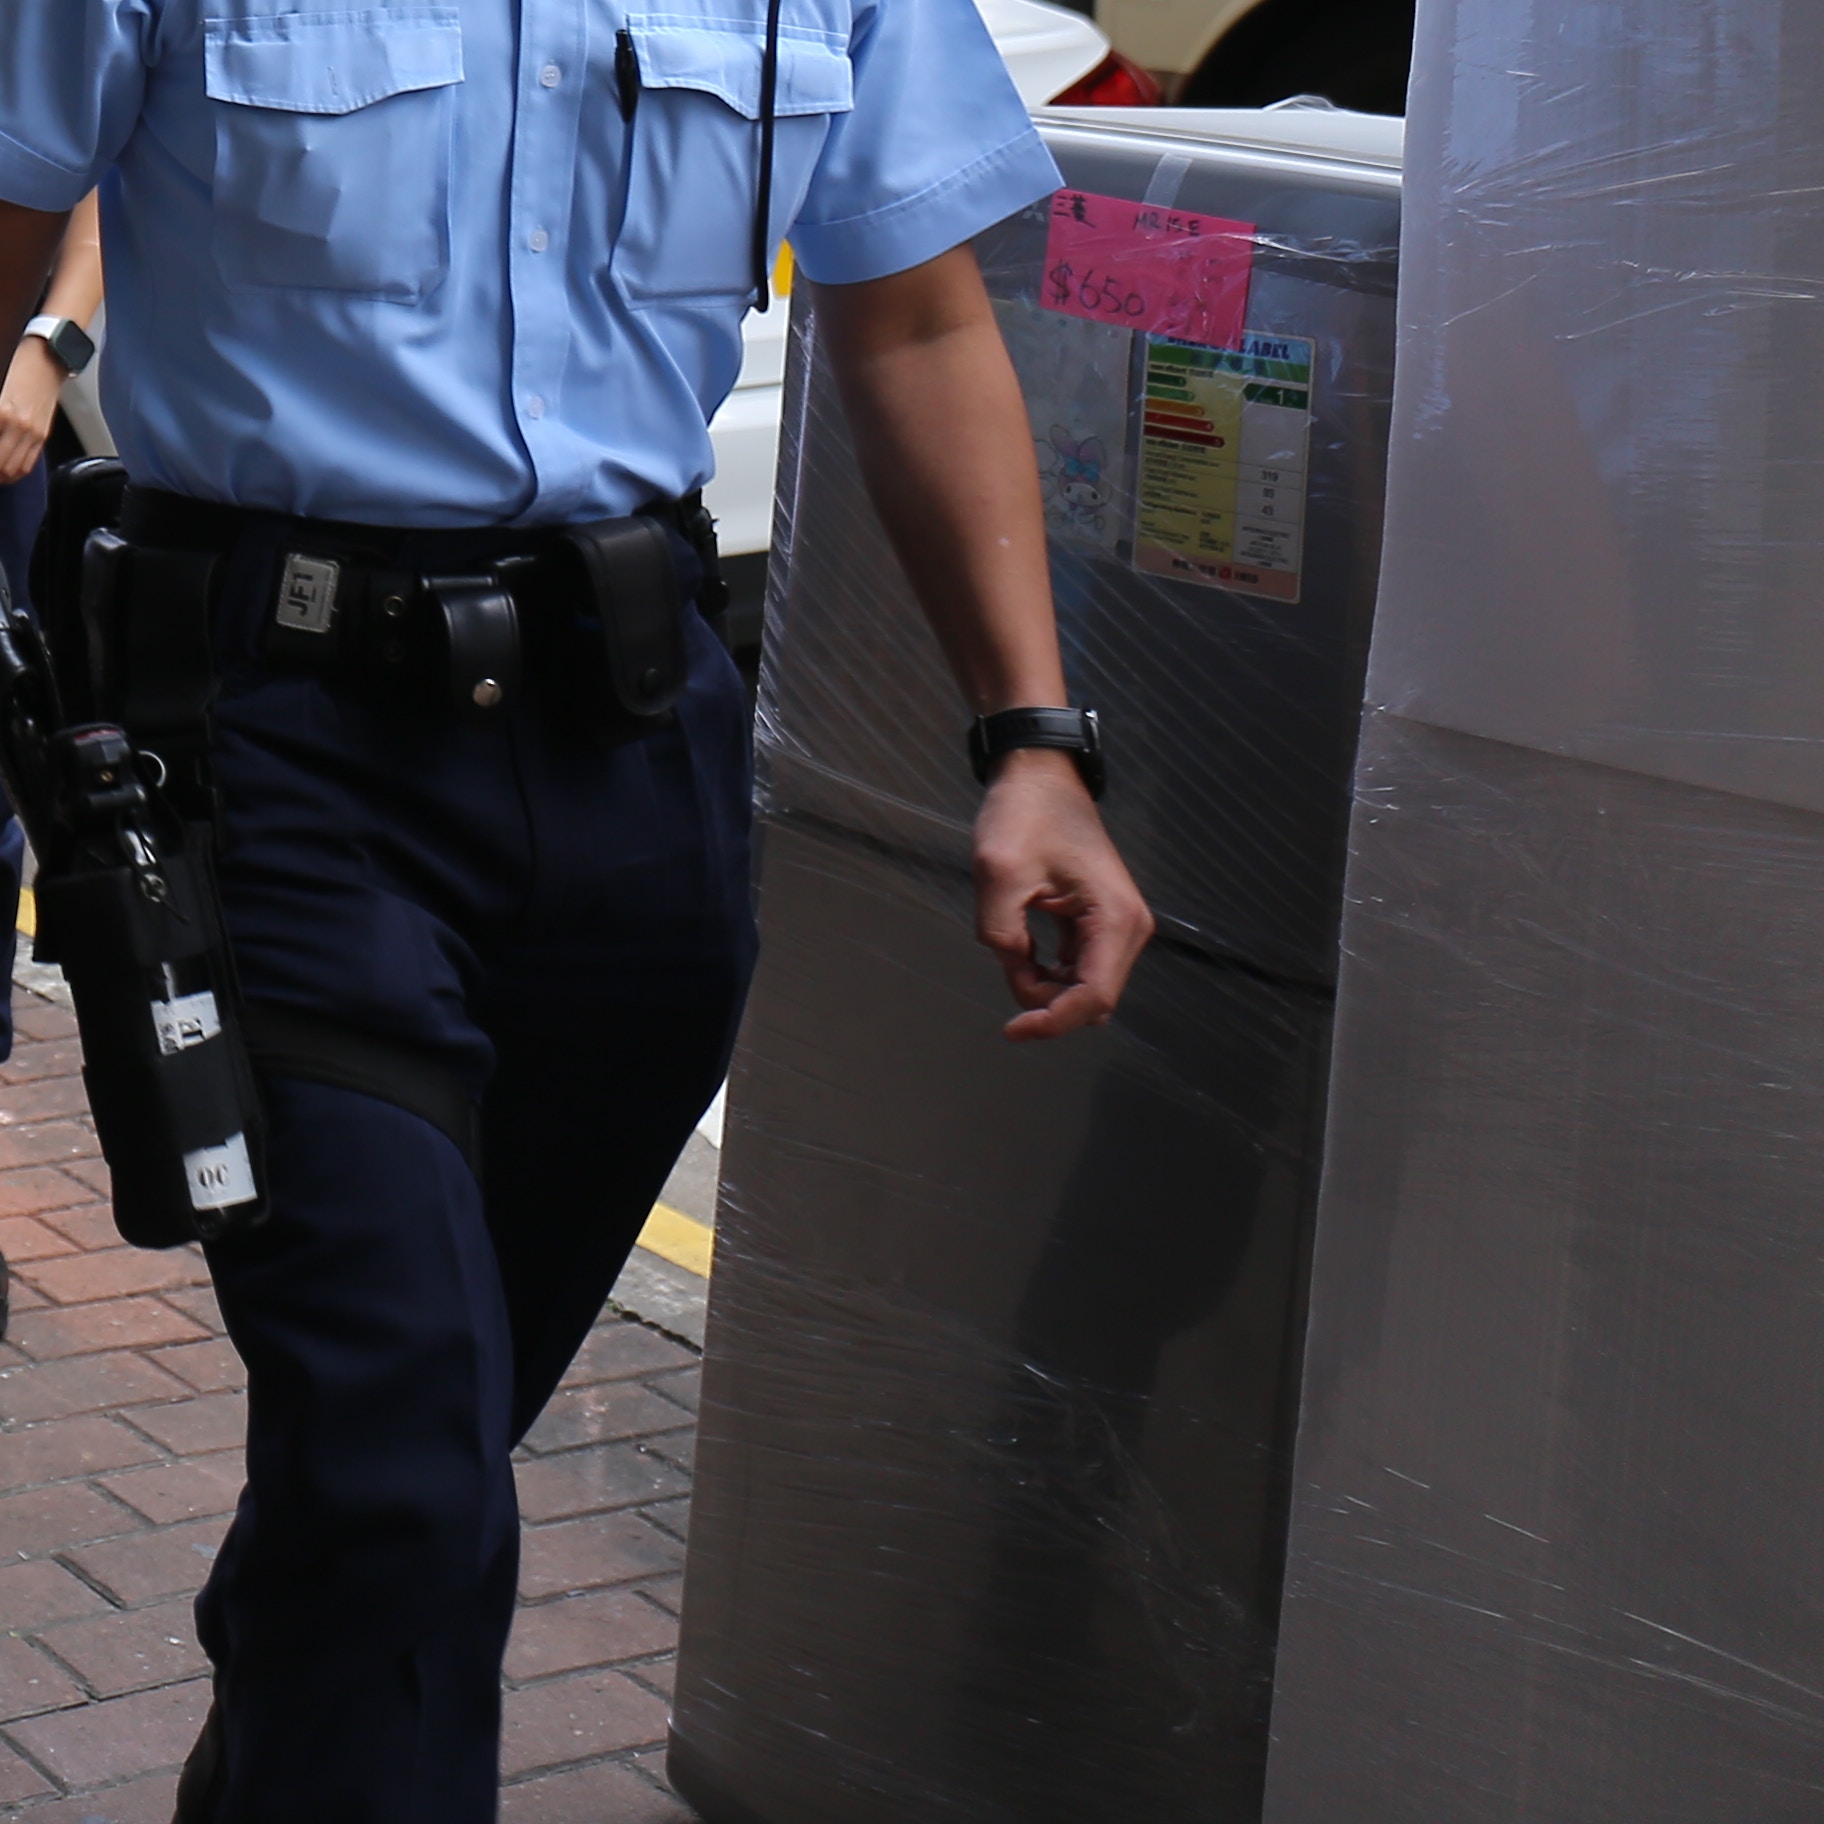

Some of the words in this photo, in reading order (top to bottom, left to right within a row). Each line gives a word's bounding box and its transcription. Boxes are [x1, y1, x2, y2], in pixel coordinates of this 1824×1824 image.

[1049, 259, 1145, 316] $650
[1276, 390, 1283, 404] 1
[287, 571, 314, 617] JF1
